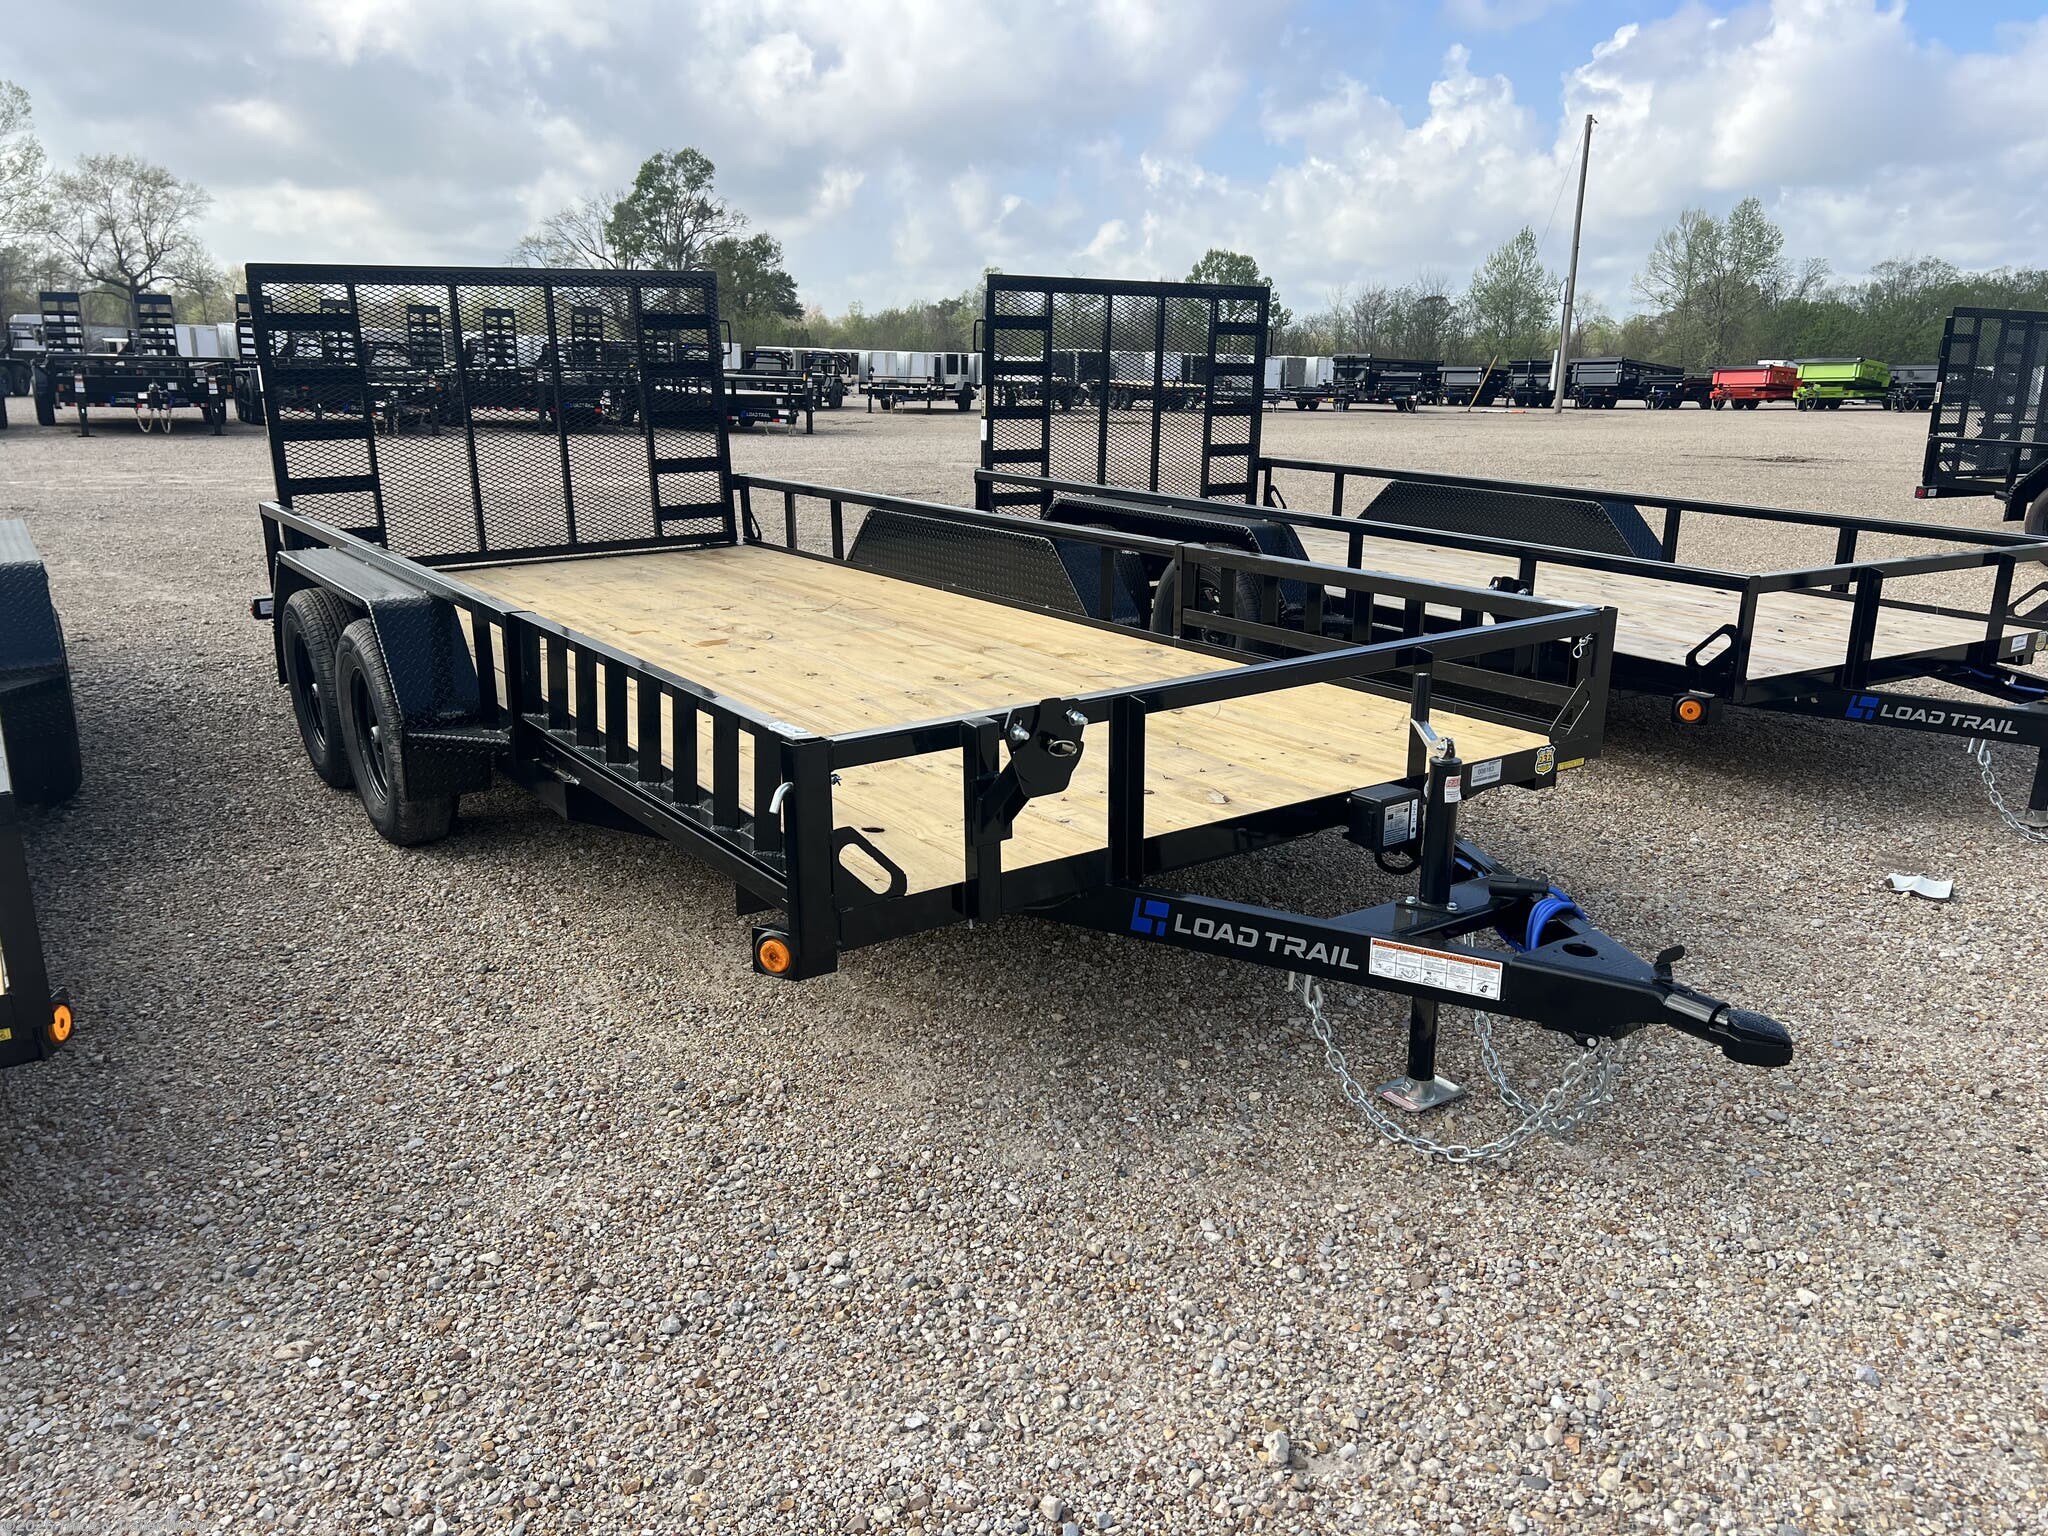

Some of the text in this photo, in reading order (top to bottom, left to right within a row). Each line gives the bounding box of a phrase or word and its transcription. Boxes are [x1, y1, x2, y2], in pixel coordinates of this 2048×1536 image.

[1880, 703, 2019, 735] LOAD TRAIL
[1174, 913, 1260, 948] LOAD
[1265, 931, 1360, 971] TRAIL
